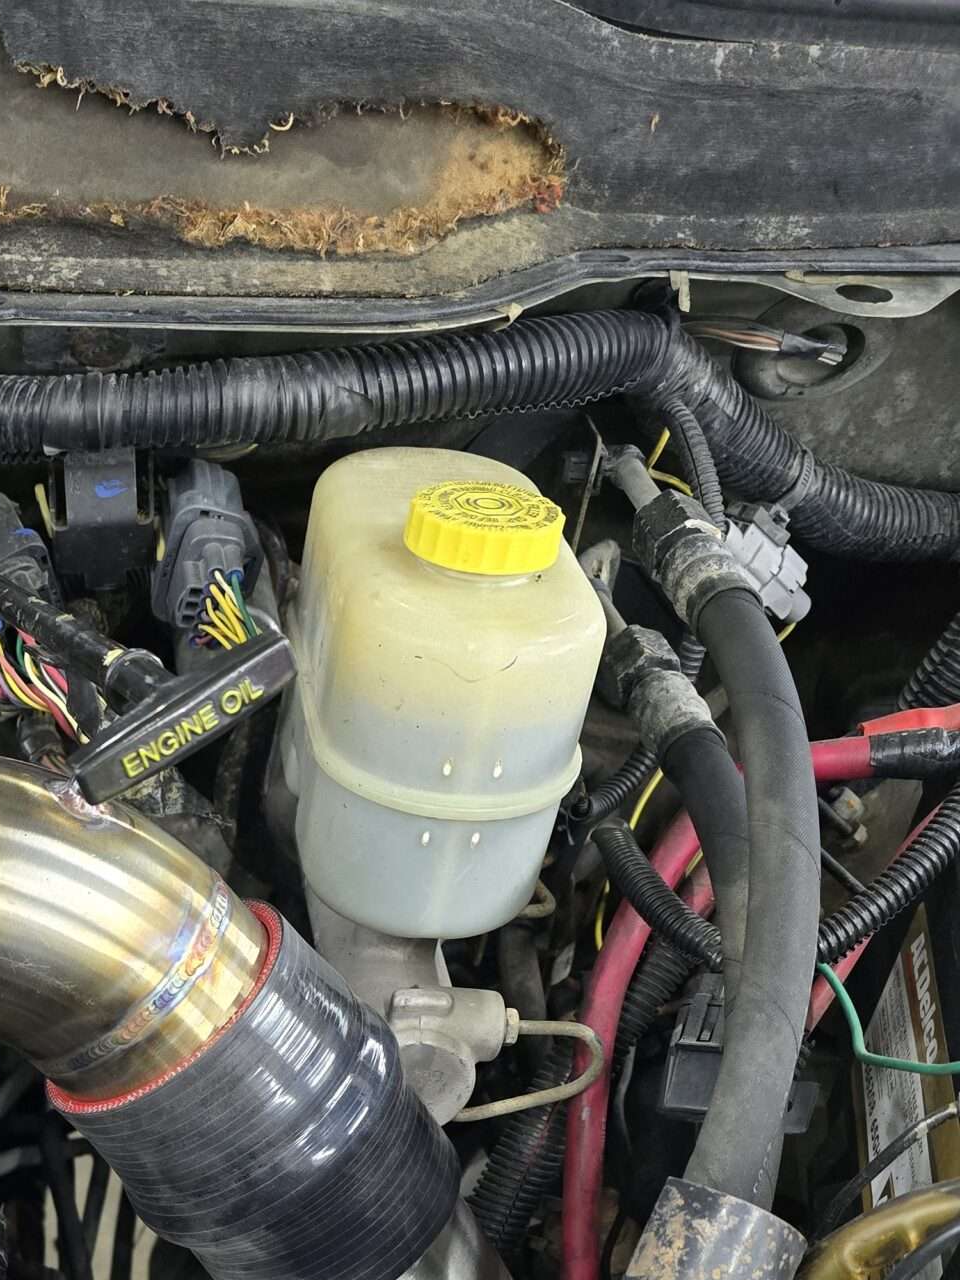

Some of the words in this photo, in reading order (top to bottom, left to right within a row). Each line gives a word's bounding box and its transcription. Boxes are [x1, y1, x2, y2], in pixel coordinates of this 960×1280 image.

[121, 700, 220, 778] ENGINE
[221, 676, 265, 715] OIL
[910, 932, 939, 1065] ACDelco
